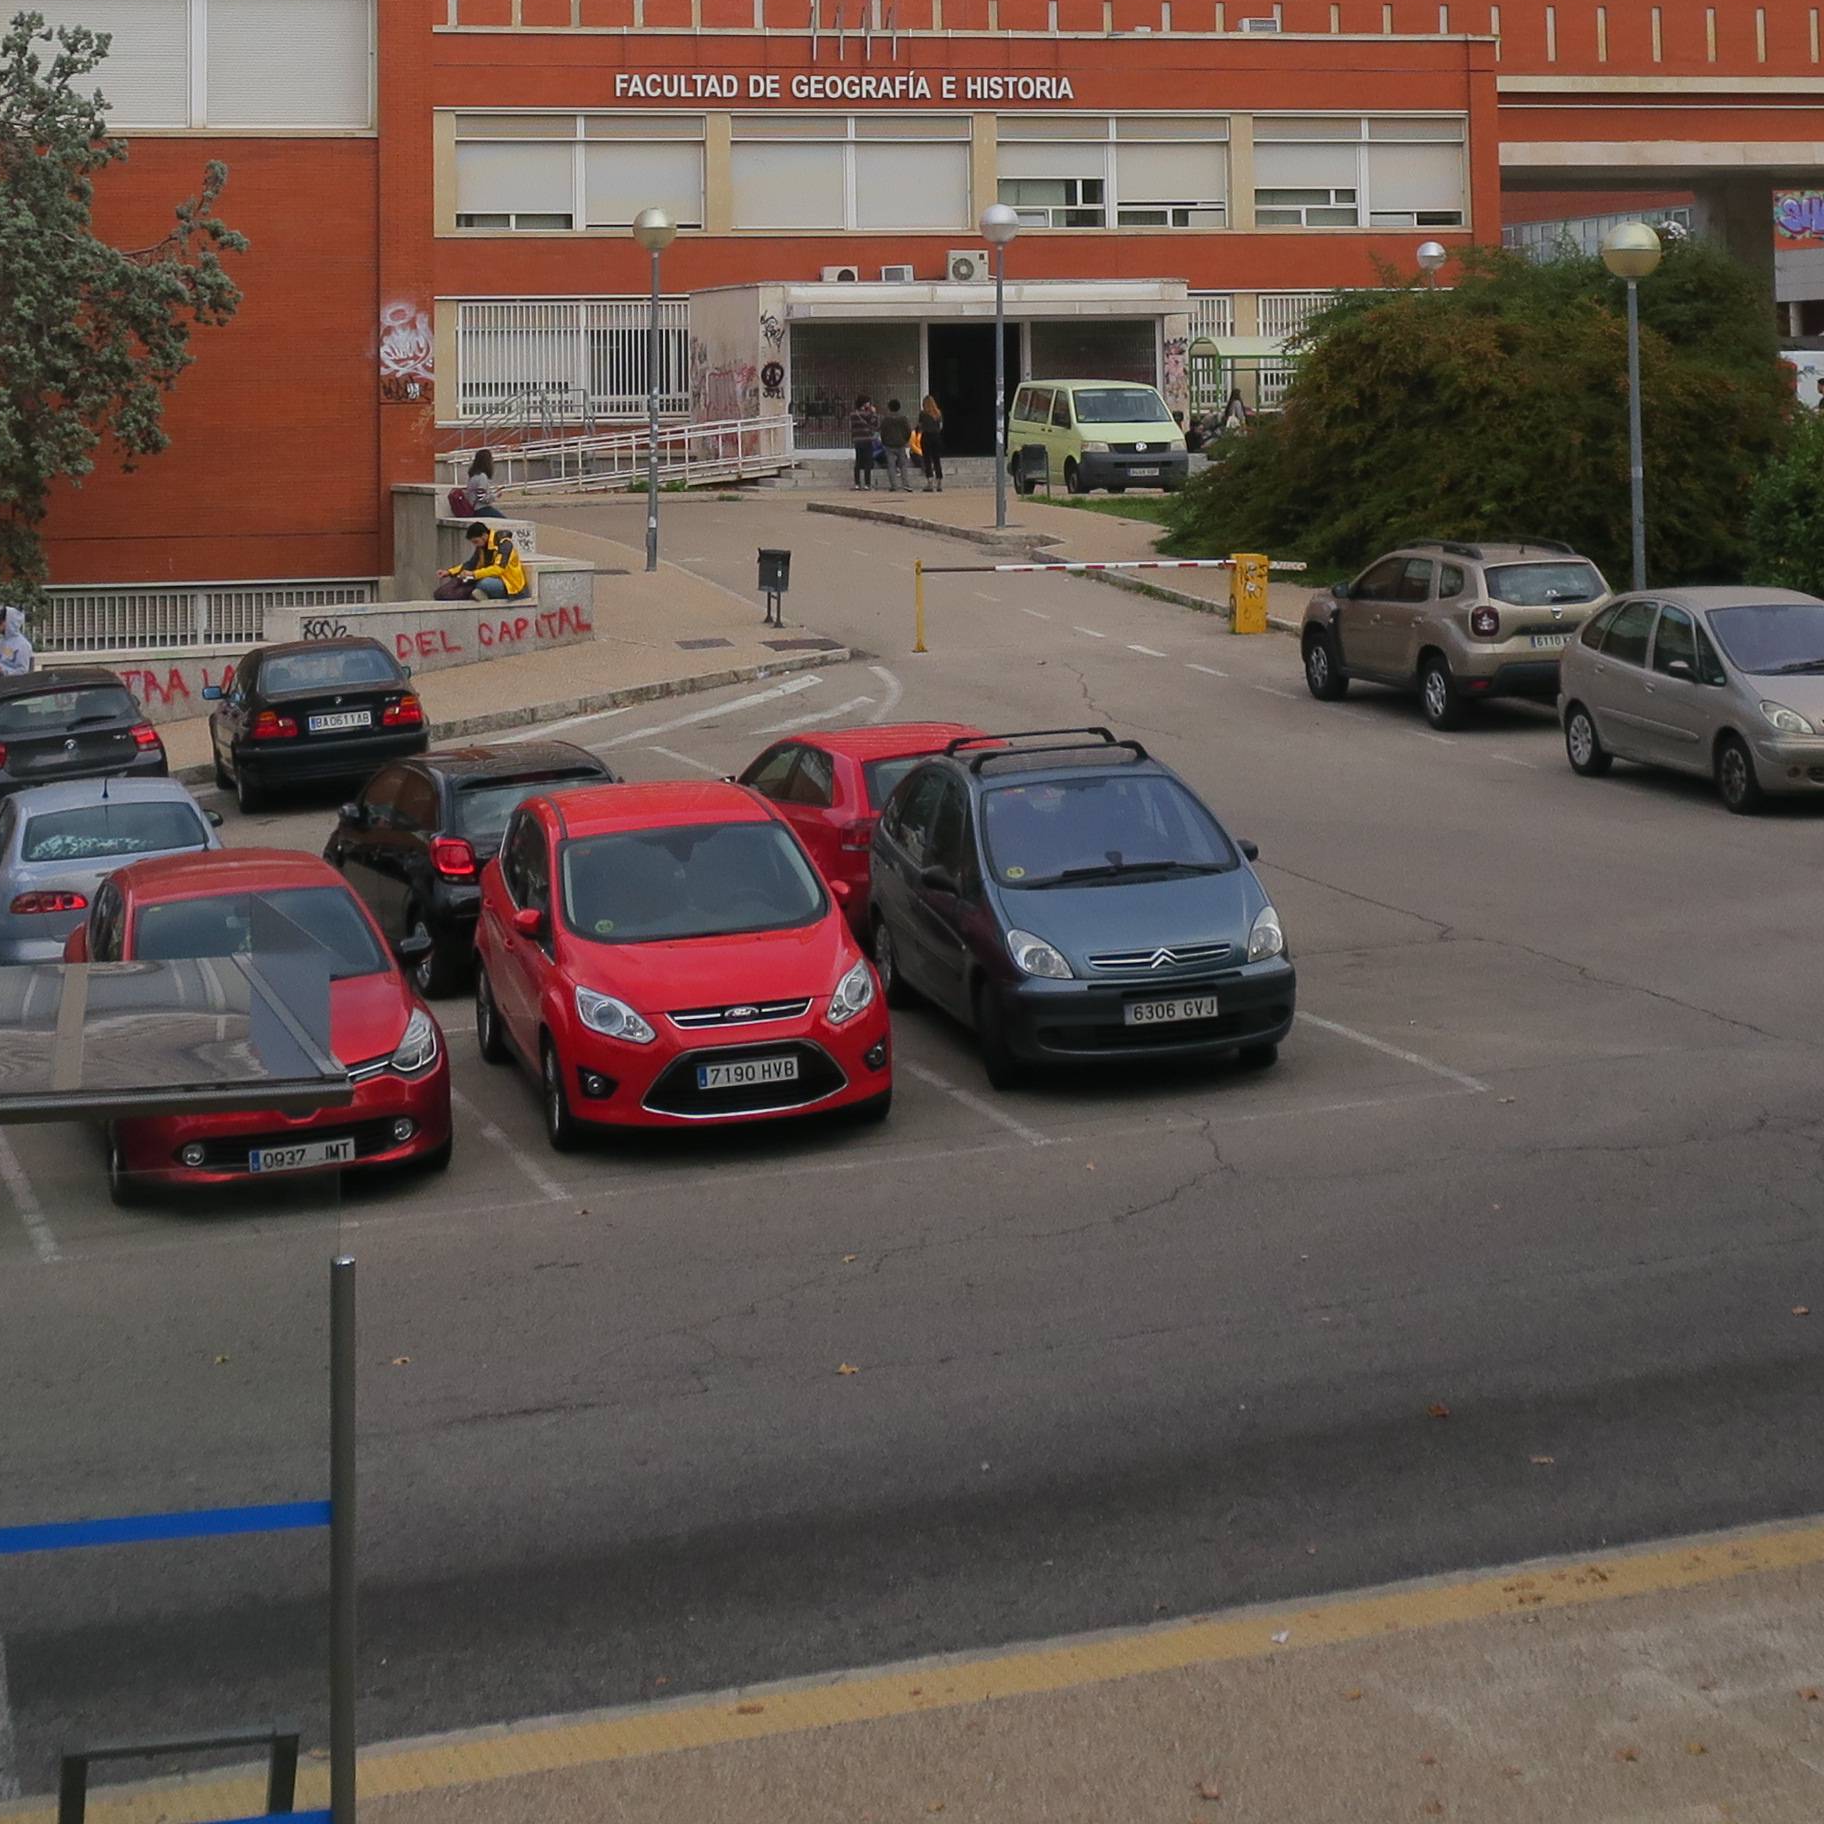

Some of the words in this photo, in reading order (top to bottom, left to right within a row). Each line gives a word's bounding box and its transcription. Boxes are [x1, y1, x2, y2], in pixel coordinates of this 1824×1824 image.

[615, 73, 740, 98] FACULTAD
[749, 74, 781, 98] DE
[791, 71, 932, 100] GEOGRAFÍA
[942, 76, 956, 99] E
[966, 76, 1074, 100] HISTORIA
[395, 629, 464, 660] DEL
[478, 605, 592, 646] CAPITAL
[1134, 1003, 1176, 1021] 6306
[1183, 999, 1214, 1017] GVJ
[710, 1065, 756, 1085] 7190
[761, 1060, 795, 1080] HVB
[263, 1148, 307, 1169] 0937
